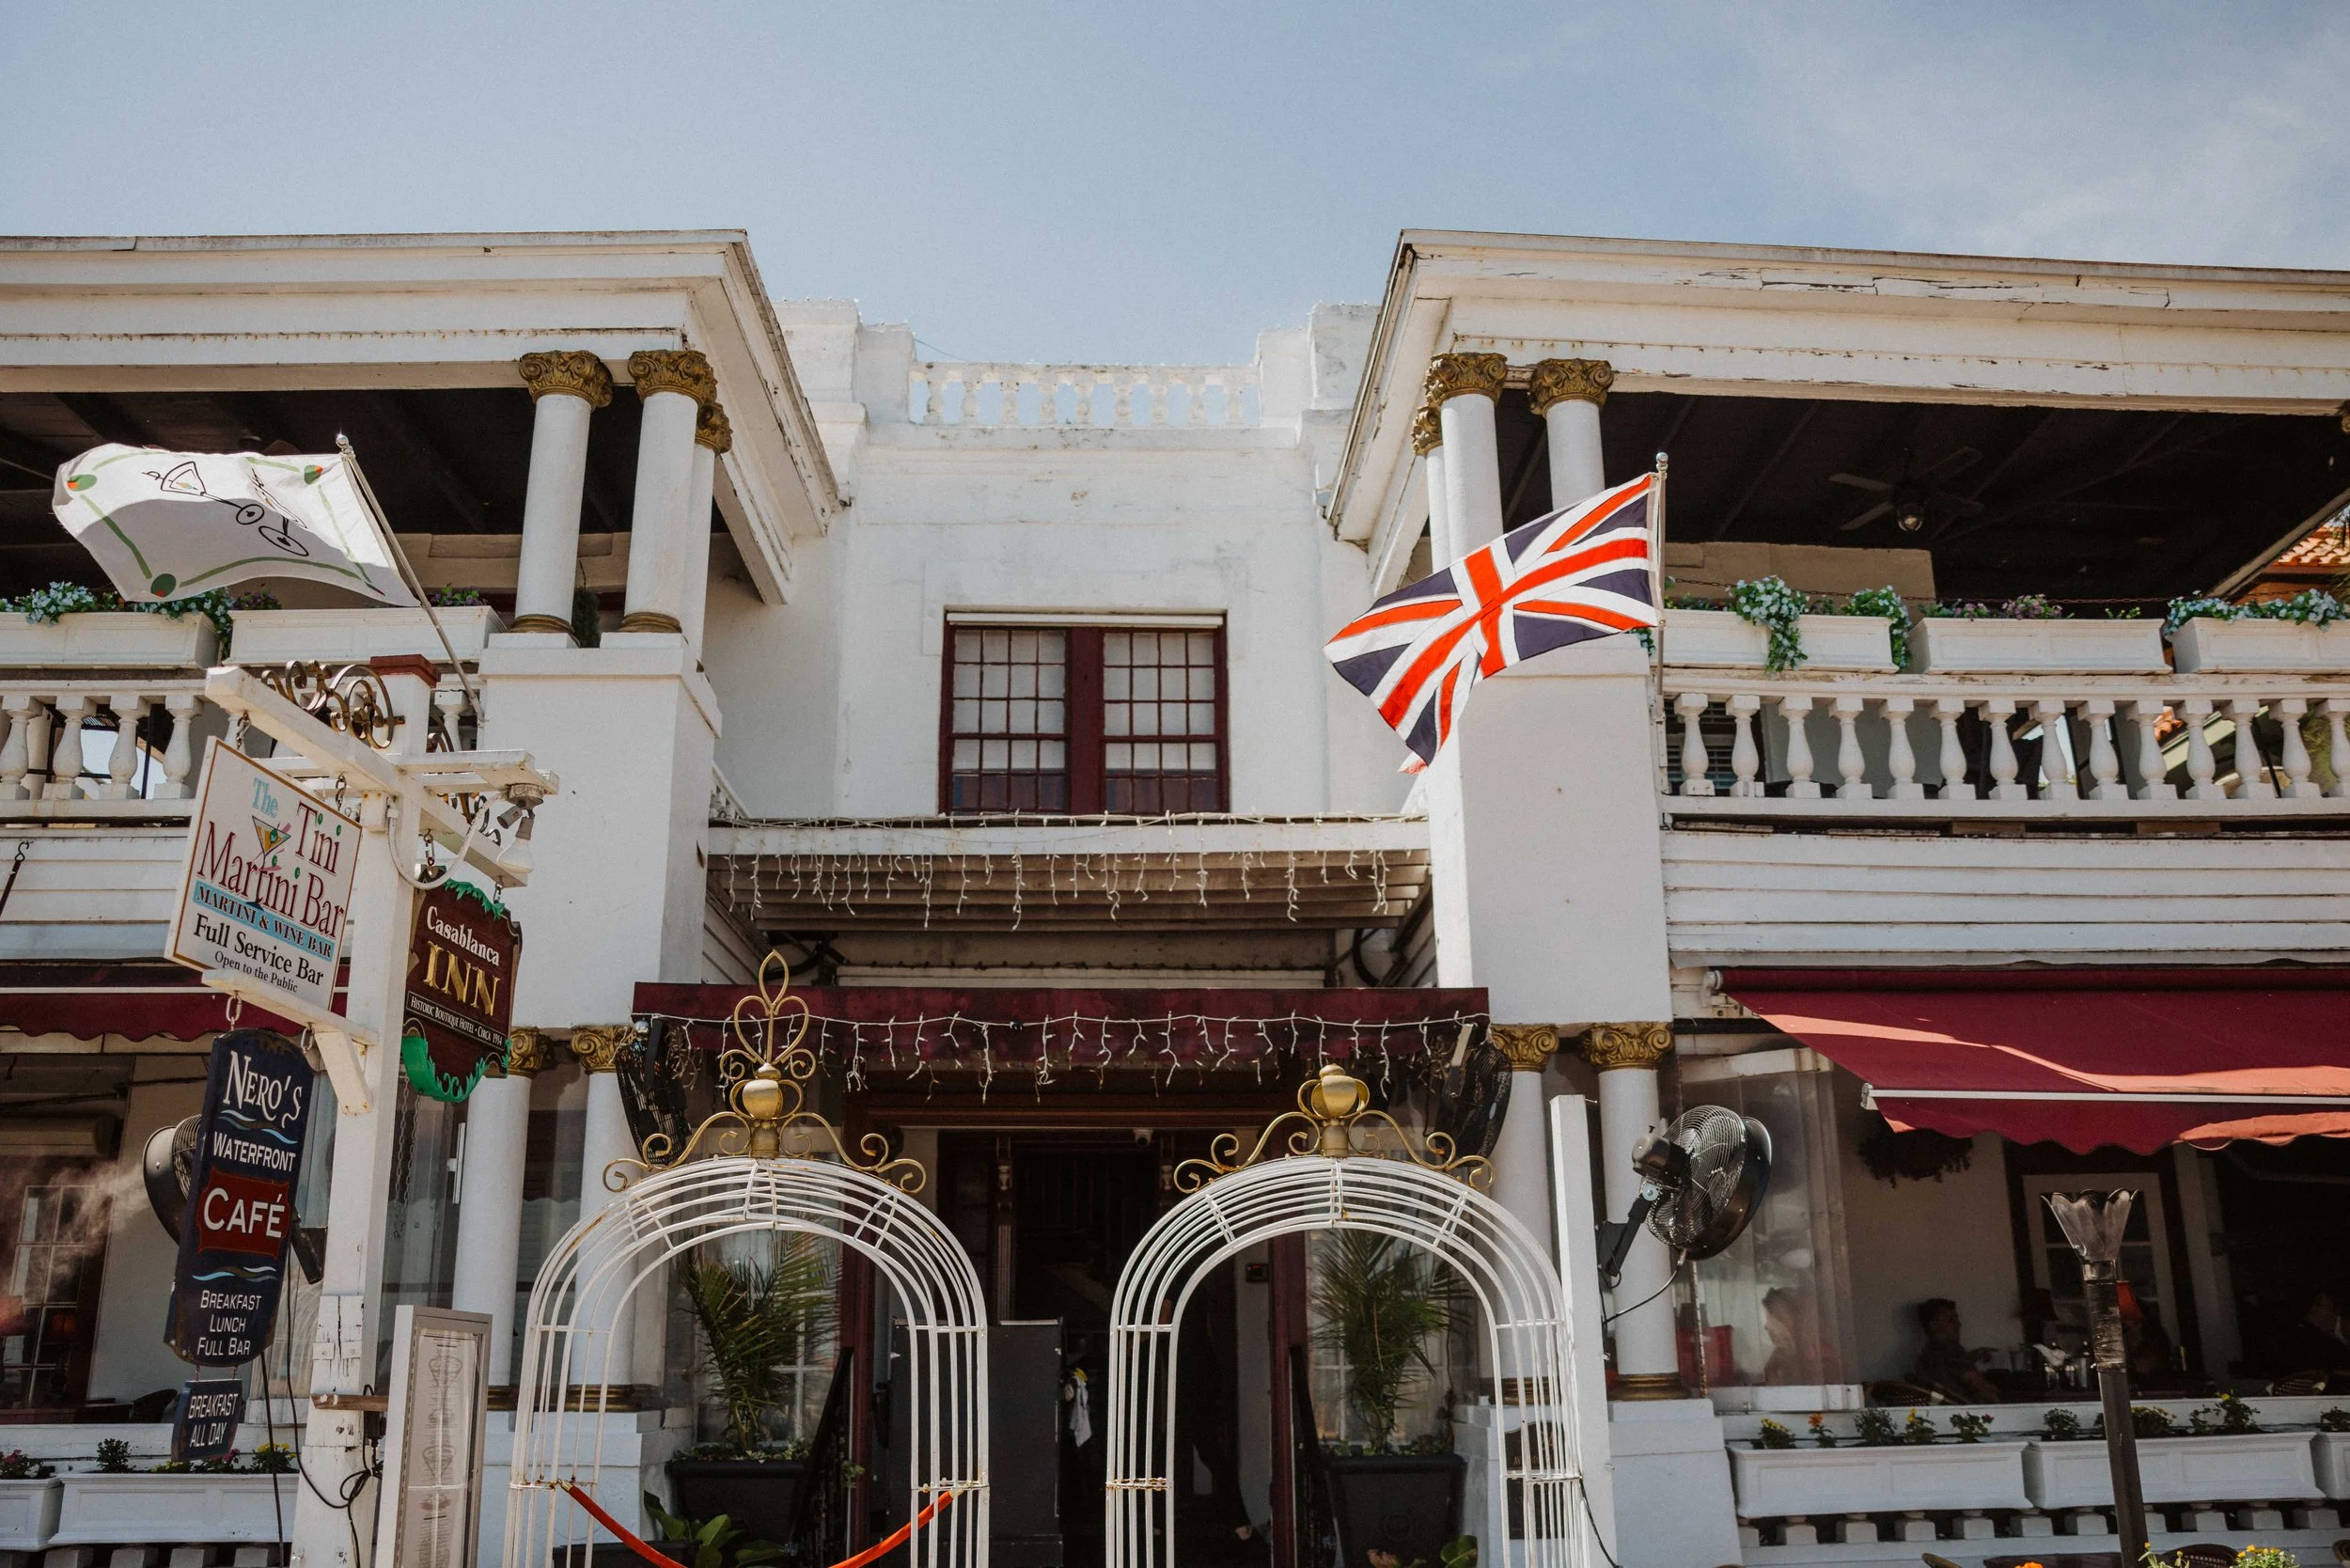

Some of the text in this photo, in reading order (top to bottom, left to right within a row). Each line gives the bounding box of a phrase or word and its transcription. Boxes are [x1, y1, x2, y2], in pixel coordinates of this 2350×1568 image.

[252, 776, 279, 819] The
[294, 800, 342, 876] Tini
[196, 821, 345, 939] Martini Bar
[196, 886, 332, 958] MARTINI & WINE BAR
[426, 905, 500, 966] Casablanca
[194, 913, 324, 986] Full Service Bar
[214, 950, 298, 993] Open to the Public
[423, 940, 501, 1016] INN
[411, 996, 434, 1017] HISTORIC
[434, 1006, 460, 1028] BOUTIQUE
[459, 1017, 475, 1033] HOTEL
[493, 1033, 504, 1046] 1914
[222, 1049, 304, 1128] NERO'S
[212, 1131, 296, 1172] WATERFRONT
[203, 1187, 286, 1239] CAFÉ
[200, 1290, 262, 1310] BREAKFAST
[209, 1314, 246, 1333] LUNCH
[196, 1337, 251, 1356] FULL BAR
[188, 1393, 238, 1419] BREAKFAST
[189, 1421, 227, 1448] ALL DAY
